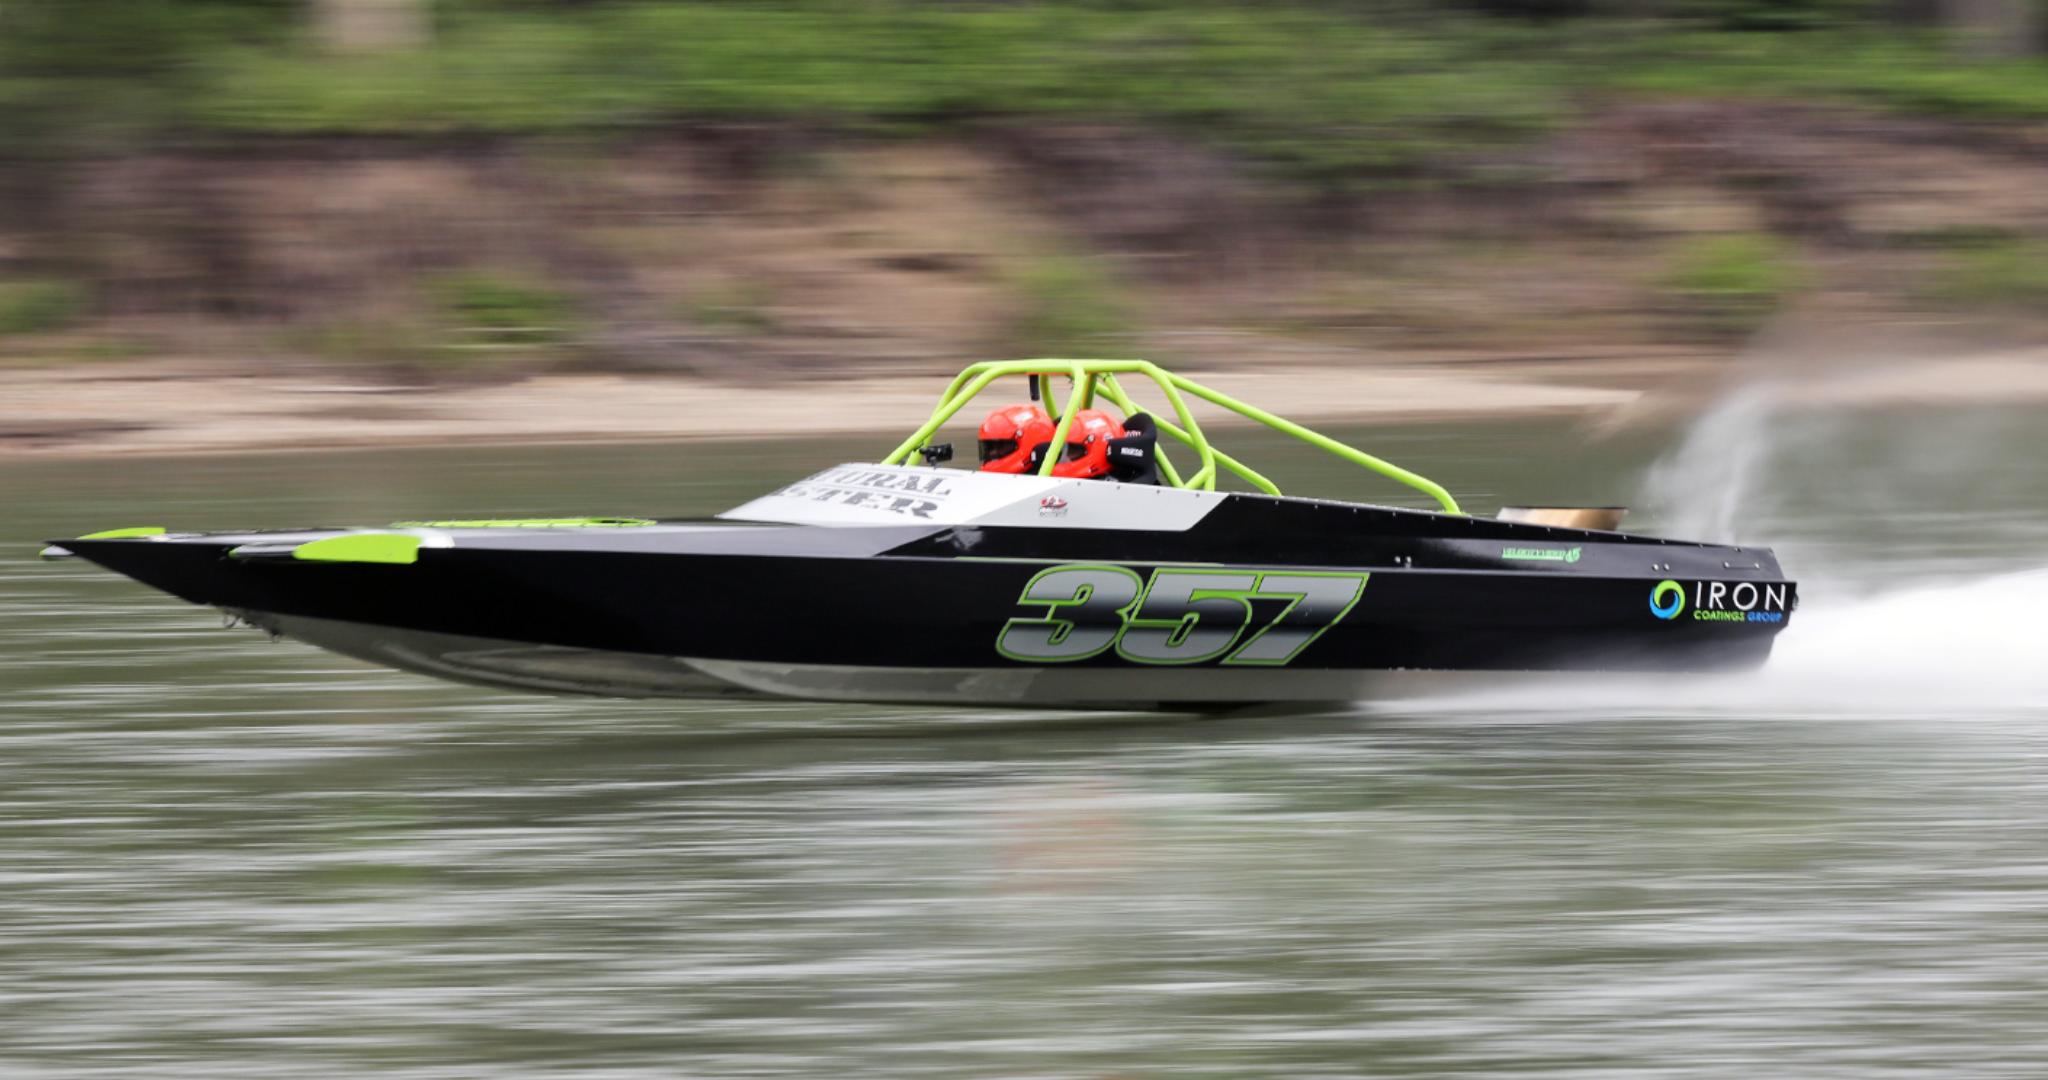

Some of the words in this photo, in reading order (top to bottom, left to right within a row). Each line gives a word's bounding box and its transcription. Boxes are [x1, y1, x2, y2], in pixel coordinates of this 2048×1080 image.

[1695, 581, 1786, 611] IRON
[996, 564, 1370, 666] 357
[1693, 610, 1745, 622] COATINGS
[1747, 611, 1783, 623] GROUP
